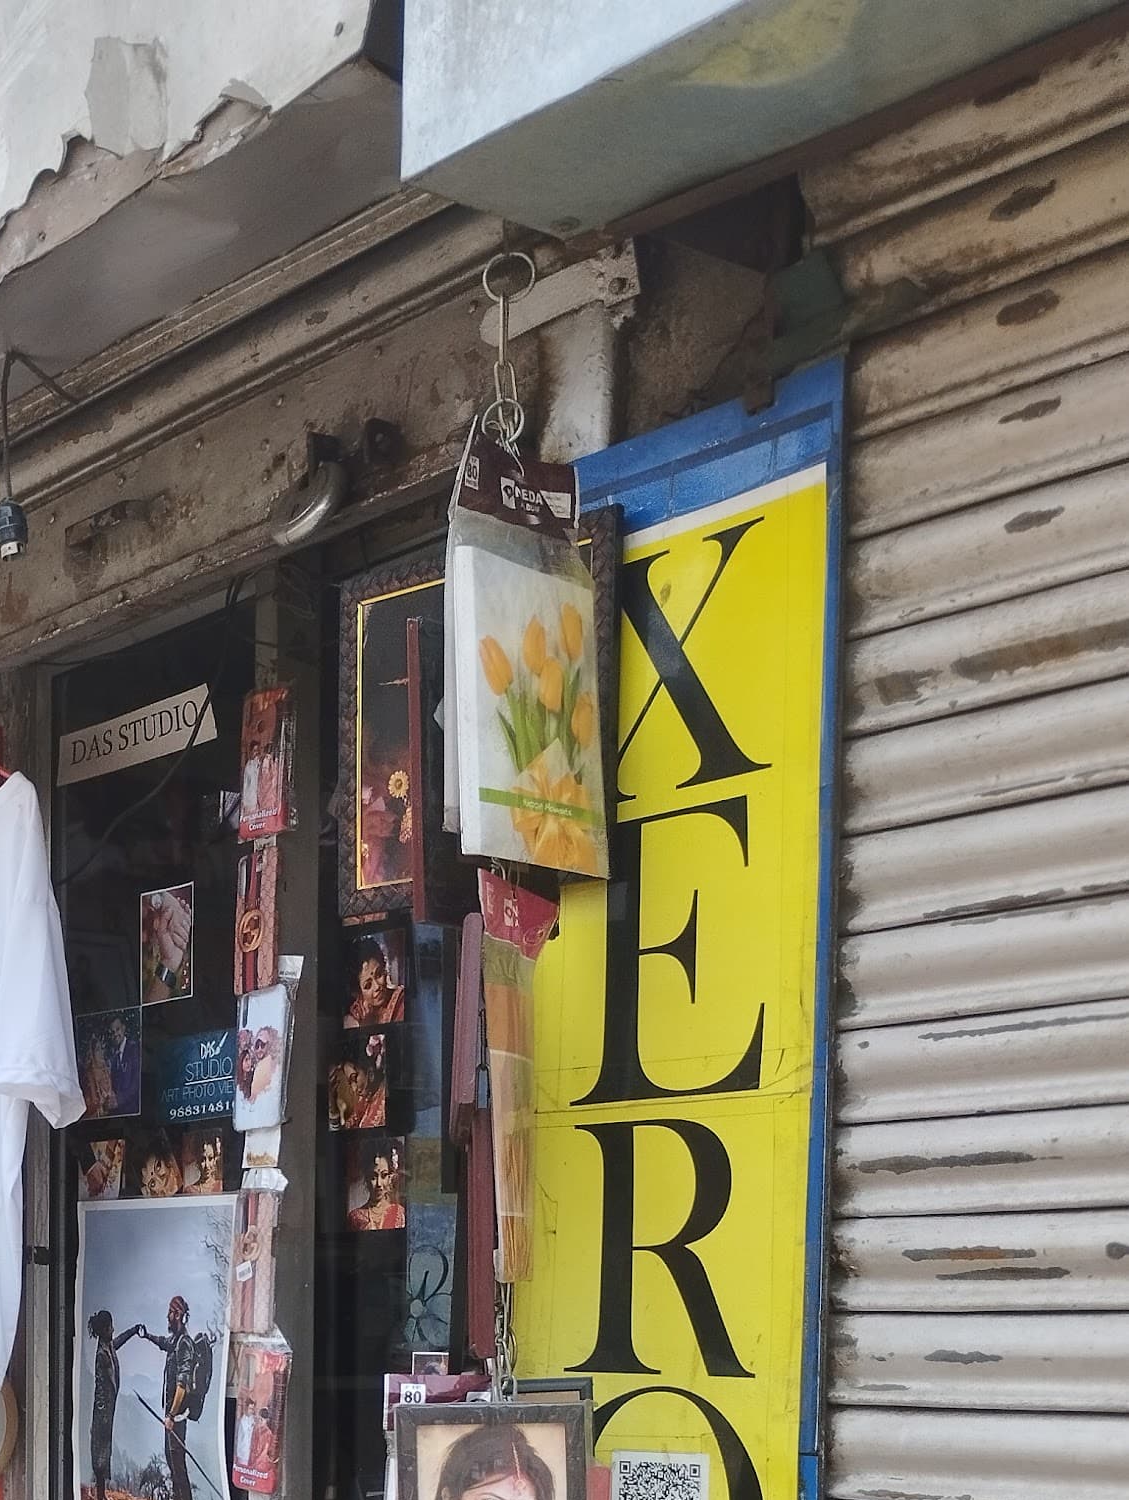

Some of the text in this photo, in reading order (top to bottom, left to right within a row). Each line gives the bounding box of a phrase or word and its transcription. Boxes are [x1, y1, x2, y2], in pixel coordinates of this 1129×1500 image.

[71, 700, 198, 765] DAS STUDIO
[200, 1040, 216, 1059] DAS
[185, 1056, 233, 1082] STUDIO
[183, 1083, 215, 1100] PHOTO
[218, 1080, 235, 1094] VIE
[170, 1100, 234, 1120] 98831481
[404, 1390, 422, 1404] 80
